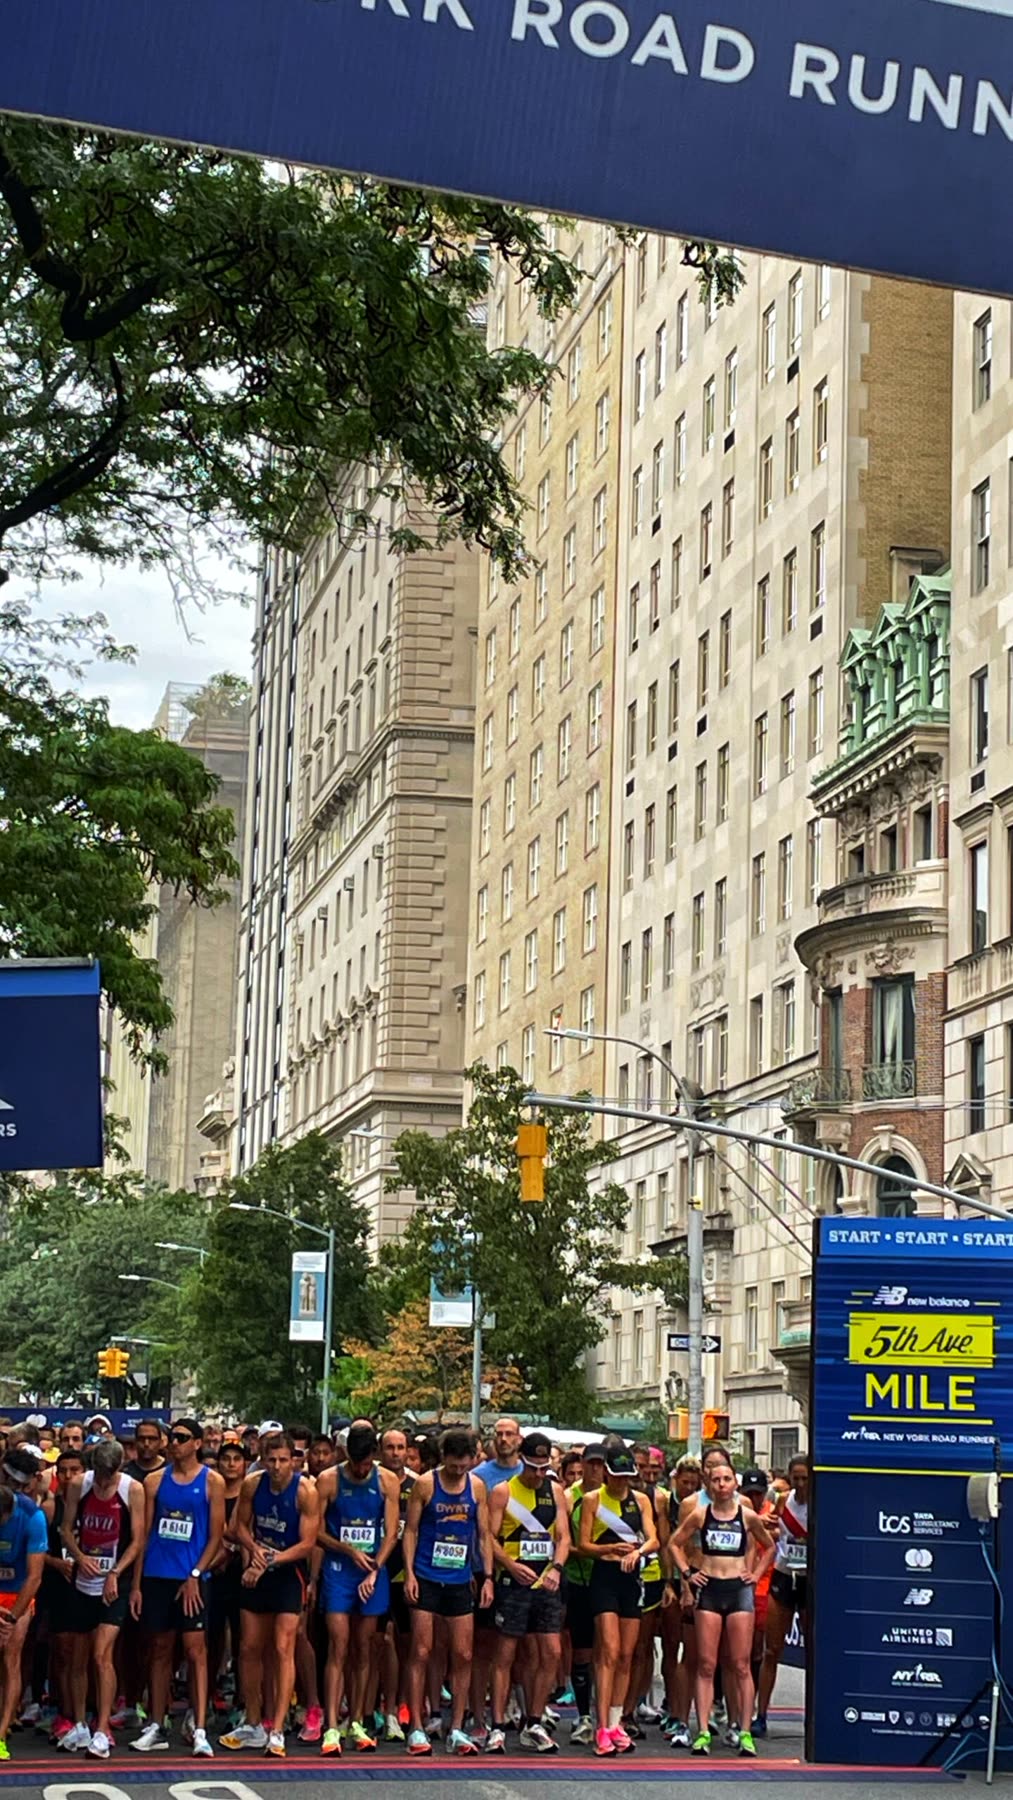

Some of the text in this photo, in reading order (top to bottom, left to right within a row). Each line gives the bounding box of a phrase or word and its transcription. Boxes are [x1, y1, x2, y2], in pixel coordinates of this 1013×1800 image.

[511, 0, 755, 83] ROAD
[829, 1230, 881, 1244] START
[895, 1232, 948, 1245] START
[907, 1297, 927, 1306] new
[928, 1297, 970, 1307] balance
[864, 1326, 974, 1358] 5th Ave
[865, 1373, 976, 1412] MILE
[883, 1433, 905, 1442] NEW
[906, 1433, 931, 1443] YORK
[931, 1434, 957, 1444] ROAD
[879, 1511, 911, 1533] tcs
[913, 1512, 934, 1520] TATA
[891, 1627, 934, 1637] UNITED
[881, 1633, 934, 1645] AIRLINES
